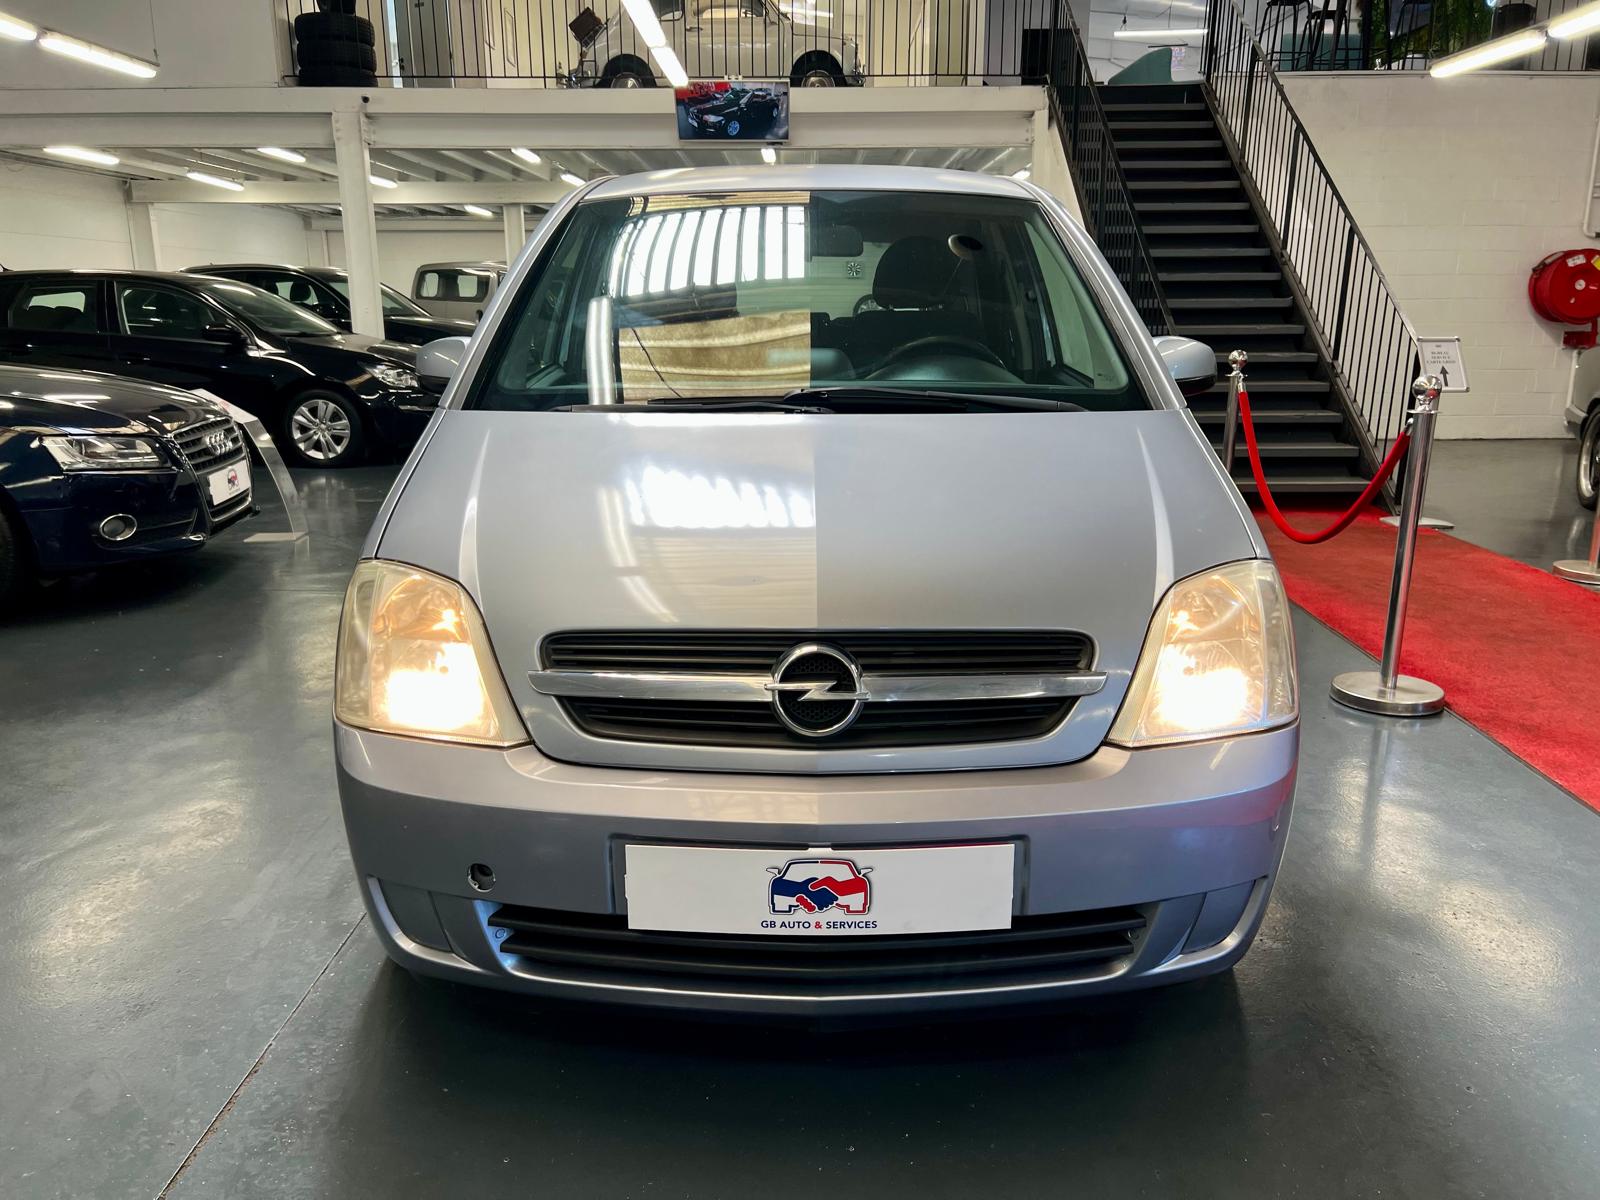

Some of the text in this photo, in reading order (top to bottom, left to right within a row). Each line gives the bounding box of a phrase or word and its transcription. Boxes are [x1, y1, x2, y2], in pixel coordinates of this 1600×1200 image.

[760, 920, 878, 929] GB AUTO & SERVICES
